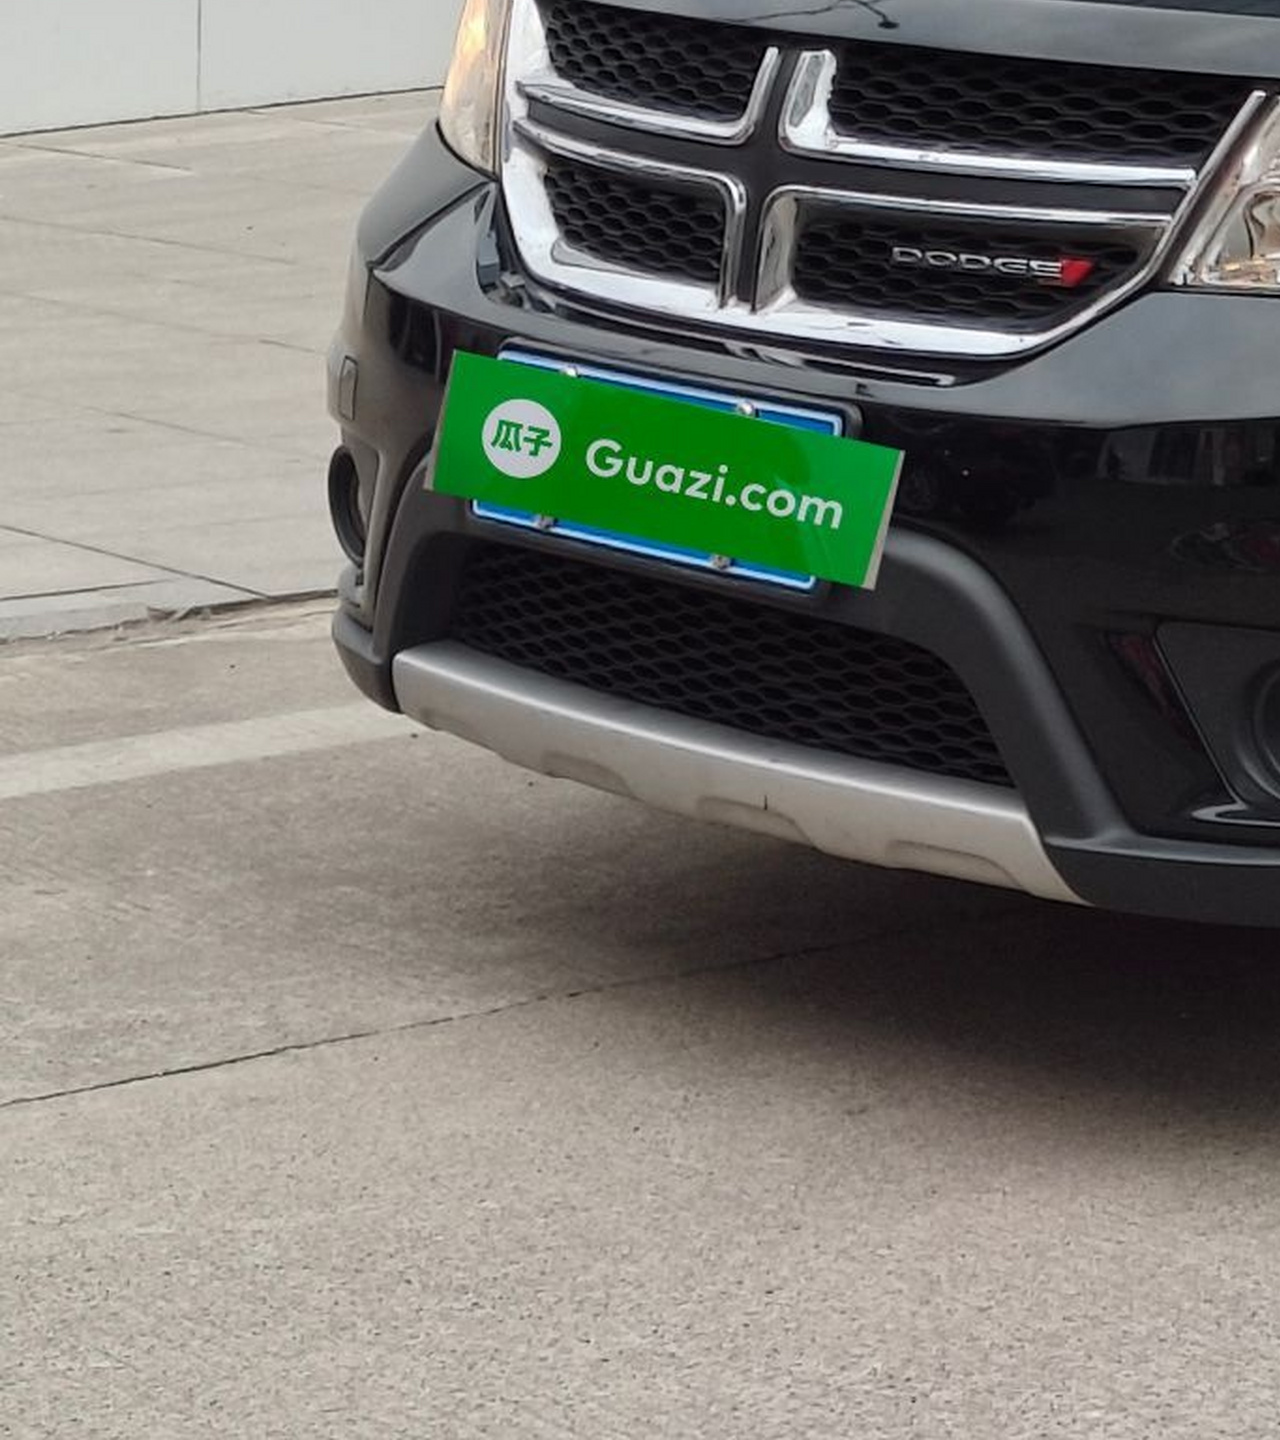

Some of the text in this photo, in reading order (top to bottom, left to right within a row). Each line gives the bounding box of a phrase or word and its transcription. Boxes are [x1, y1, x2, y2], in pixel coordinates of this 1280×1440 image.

[893, 247, 1063, 278] DODGE
[491, 419, 553, 457] 瓜子
[585, 438, 843, 530] Guazi.com
